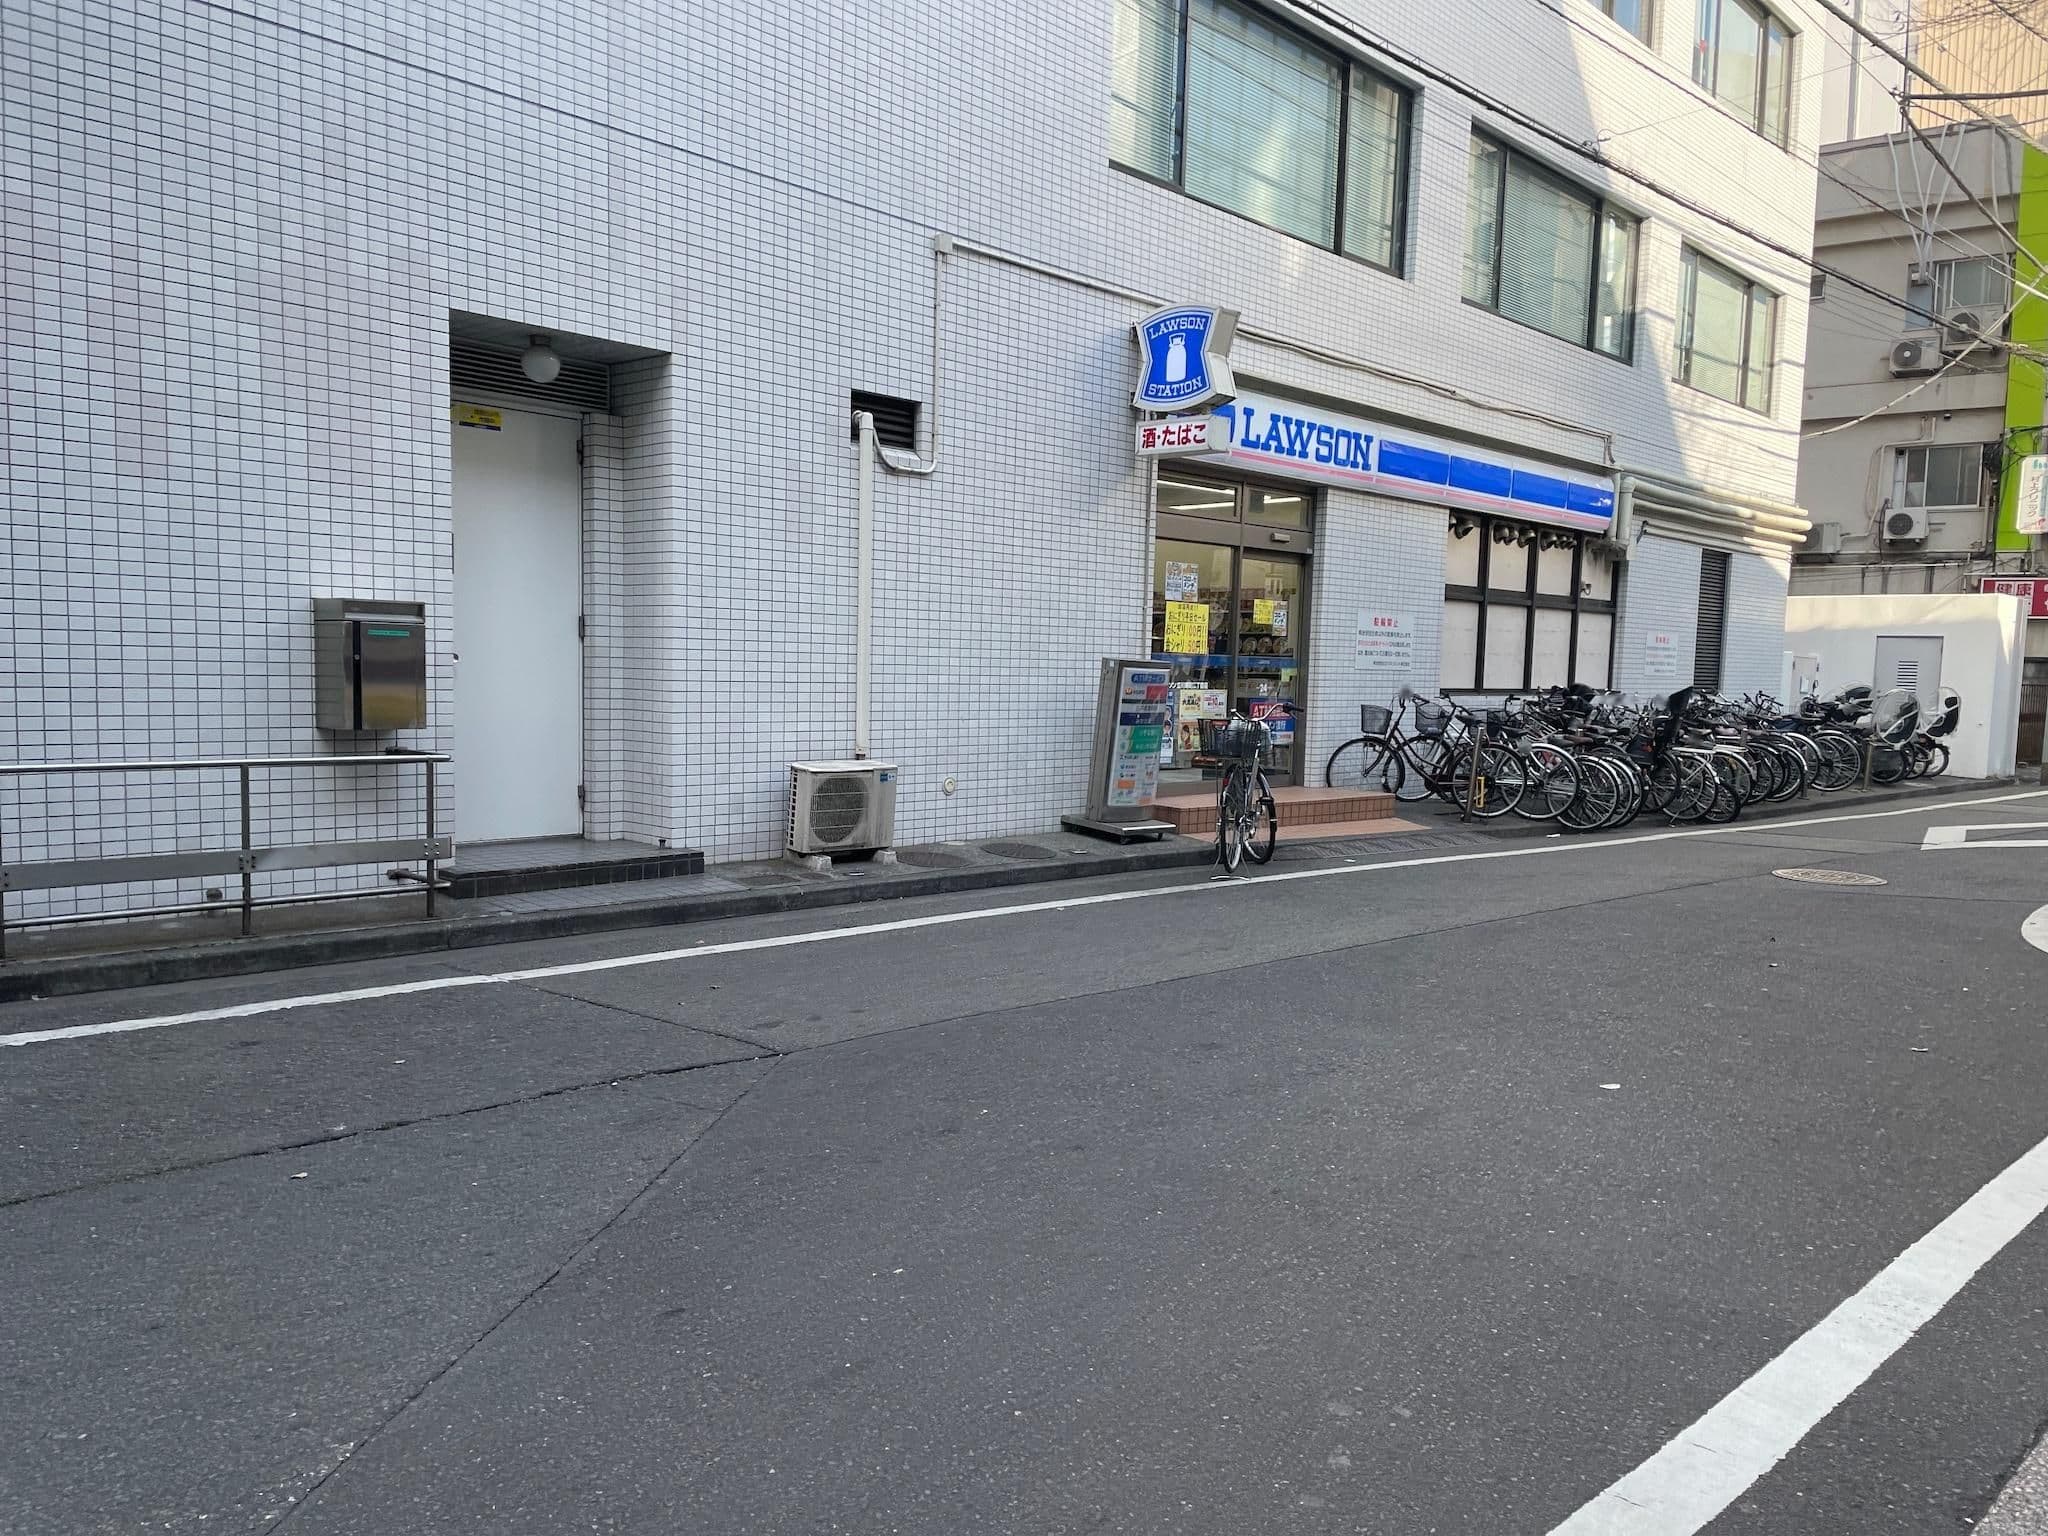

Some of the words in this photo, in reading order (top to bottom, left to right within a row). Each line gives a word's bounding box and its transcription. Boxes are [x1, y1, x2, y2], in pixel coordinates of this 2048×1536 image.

[1149, 316, 1206, 339] LAWSON
[1148, 376, 1203, 397] STATION
[1240, 406, 1374, 472] LAWSON
